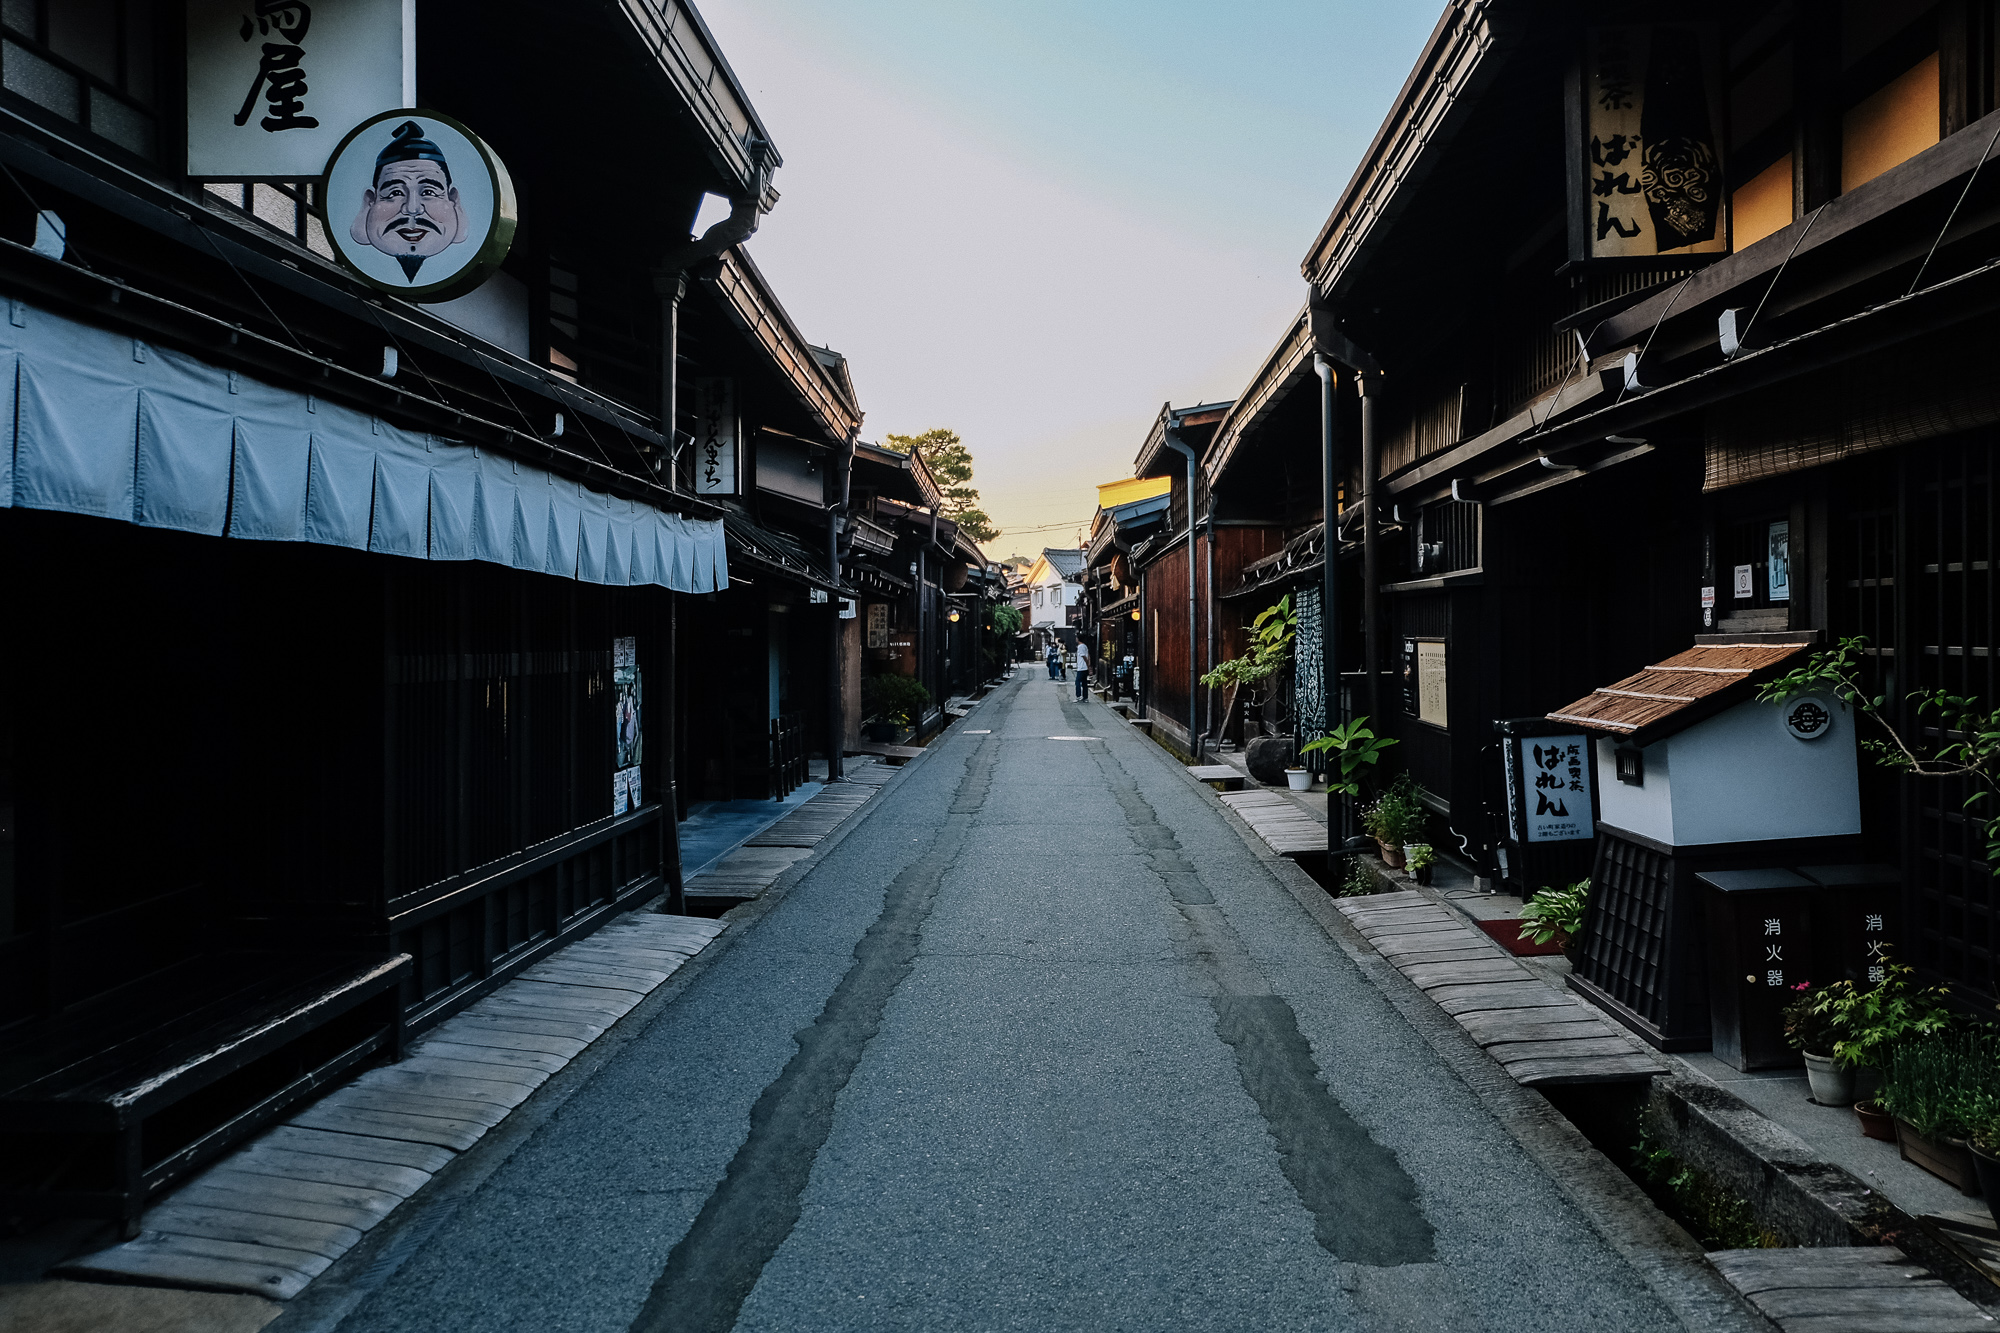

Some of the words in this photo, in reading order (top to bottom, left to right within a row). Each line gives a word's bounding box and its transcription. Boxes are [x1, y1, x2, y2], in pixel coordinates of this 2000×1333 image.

[1591, 134, 1642, 242] ばれん
[1533, 744, 1569, 817] ばれん
[1567, 744, 1585, 793] 版画喫茶
[1764, 917, 1784, 987] 消火器
[1865, 913, 1886, 983] 消火器
